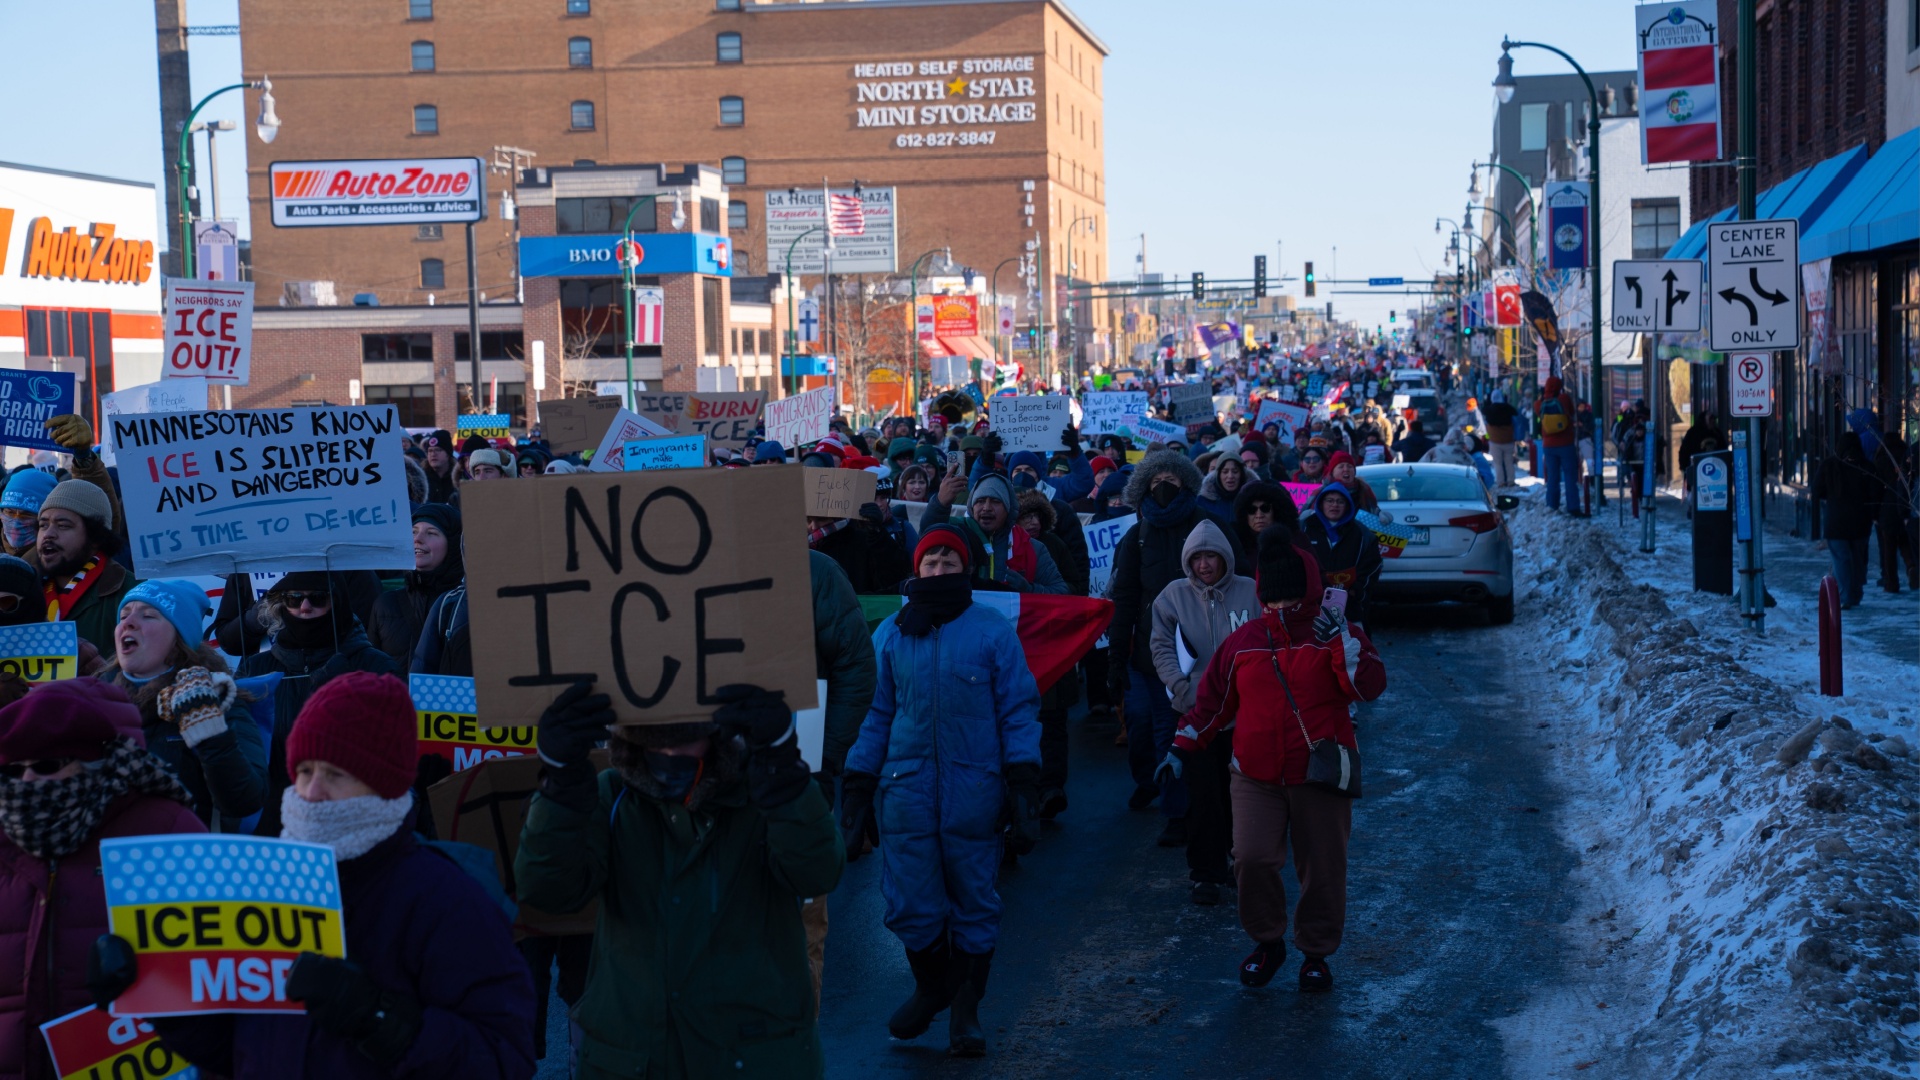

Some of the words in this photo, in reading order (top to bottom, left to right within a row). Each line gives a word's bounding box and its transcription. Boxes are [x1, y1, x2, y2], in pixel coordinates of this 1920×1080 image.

[1652, 36, 1701, 46] GATEWAY
[854, 62, 914, 78] HEATED
[919, 60, 958, 75] SELF
[963, 56, 1035, 74] STORAGE
[857, 80, 946, 102] NORTH
[969, 77, 1036, 98] STAR
[857, 106, 917, 127] MINI
[920, 102, 1037, 125] STORAGE
[896, 131, 996, 147] 612-827-3847
[326, 167, 470, 198] AutoZone
[292, 206, 319, 216] Auto
[321, 205, 350, 215] Parts
[358, 203, 426, 214] Accessories
[434, 202, 471, 212] Advice
[1720, 227, 1786, 242] CENTER
[27, 216, 154, 284] AutoZone
[569, 248, 611, 262] BMO
[1730, 244, 1776, 258] LANE
[174, 296, 225, 307] NEIGHBORS
[227, 299, 242, 308] SAY
[174, 308, 238, 342] ICE
[1617, 315, 1651, 326] ONLY
[1731, 330, 1777, 343] ONLY
[171, 341, 241, 374] OUT!
[694, 398, 760, 420] BURN
[767, 387, 827, 428] IMMIGRANTS
[1014, 400, 1043, 414] Ignore
[1046, 400, 1062, 411] Evil
[1124, 403, 1145, 414] ICE
[114, 411, 294, 449] MINNESOTANS
[311, 408, 393, 436] KNOW
[457, 428, 478, 438] ICE
[481, 427, 509, 438] OUT
[692, 419, 749, 442] ICE
[767, 412, 826, 449] WELCOME
[995, 424, 1049, 436] Accomplice
[146, 451, 200, 483] ICE
[215, 447, 248, 473] IS
[262, 437, 375, 470] SLIPPERY
[628, 442, 698, 458] Immigrants
[653, 455, 673, 464] make
[156, 482, 217, 513] AND
[231, 463, 382, 498] DANGEROUS
[818, 474, 850, 489] Fuck
[815, 491, 850, 512] Trump
[139, 528, 183, 558] IT'S
[191, 521, 248, 547] TIME
[257, 516, 290, 535] TO
[564, 484, 712, 575] NO
[1088, 524, 1121, 552] ICE
[1378, 533, 1404, 547] OUT
[1089, 555, 1108, 569] OUT
[1089, 576, 1106, 594] We
[496, 577, 786, 709] ICE
[0, 658, 65, 680] OUT
[424, 713, 477, 742] ICE
[135, 906, 224, 949] ICE
[235, 905, 327, 950] OUT
